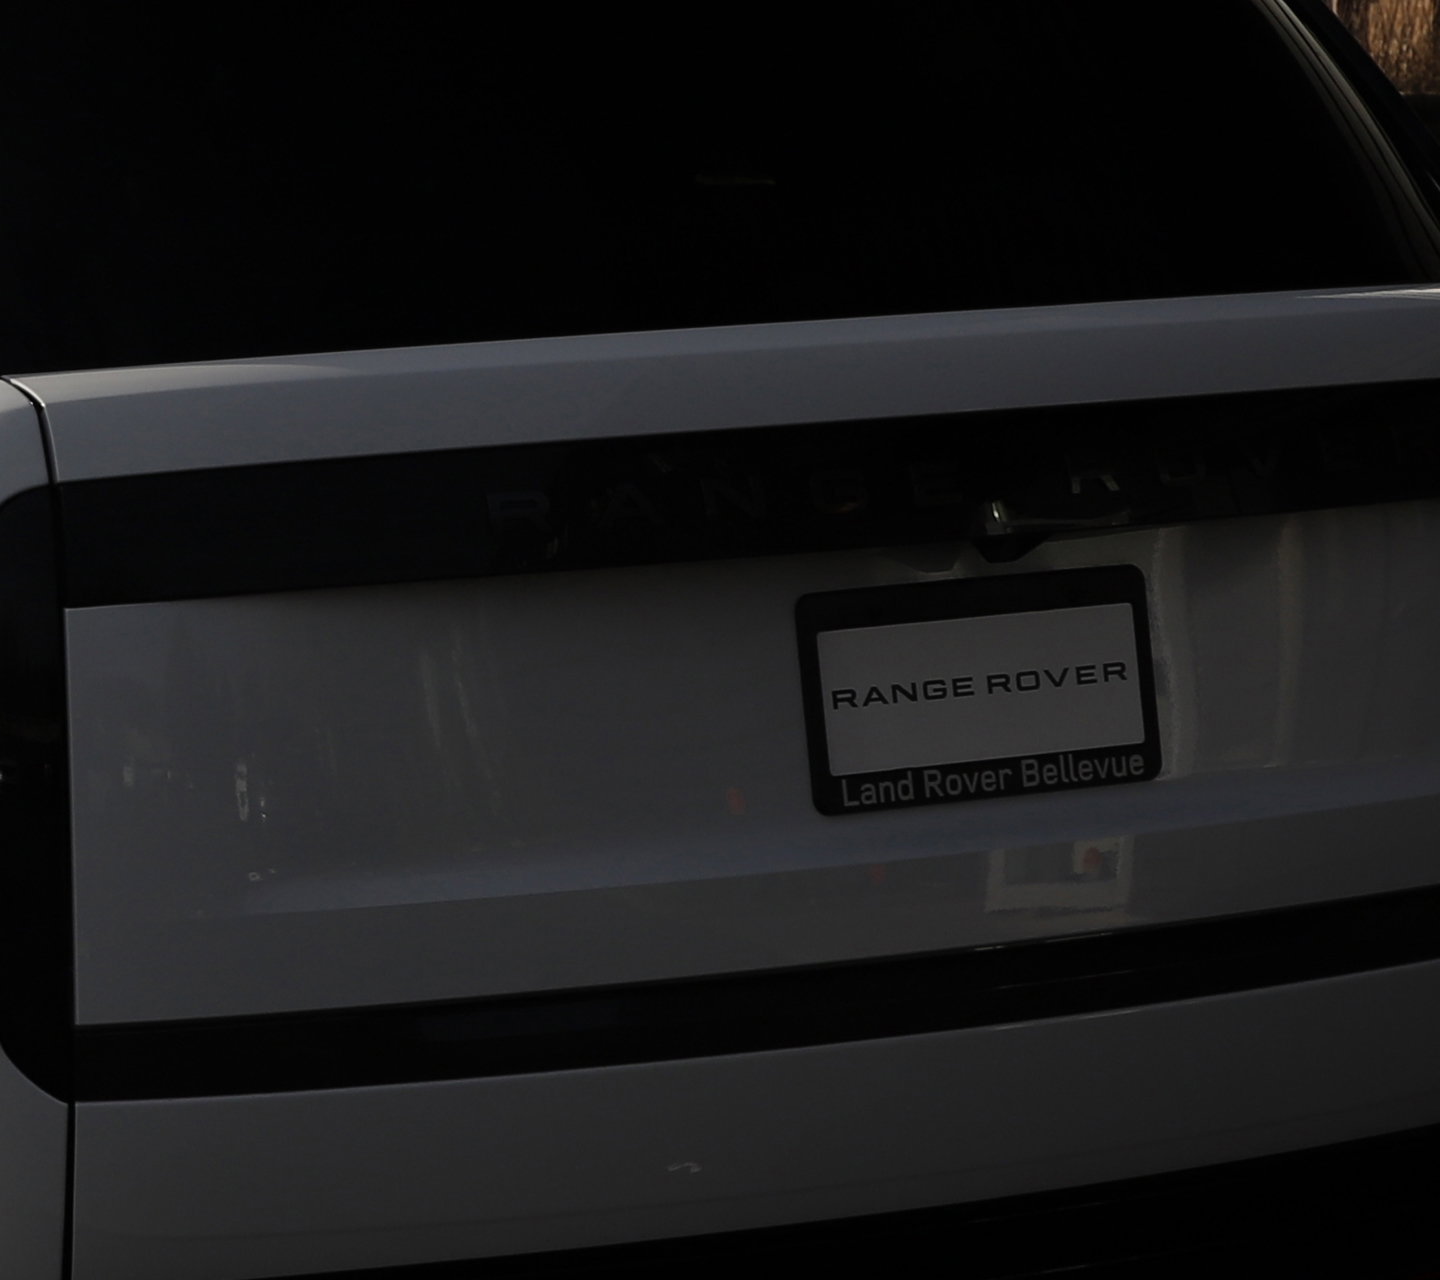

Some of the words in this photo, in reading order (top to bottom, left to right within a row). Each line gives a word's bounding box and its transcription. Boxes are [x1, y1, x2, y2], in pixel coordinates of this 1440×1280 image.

[485, 460, 963, 532] RANGE
[831, 676, 975, 710] RANGE
[986, 661, 1128, 695] ROVER
[841, 772, 915, 807] Land
[924, 767, 1012, 799] Rover
[1021, 752, 1145, 789] Bellevue
